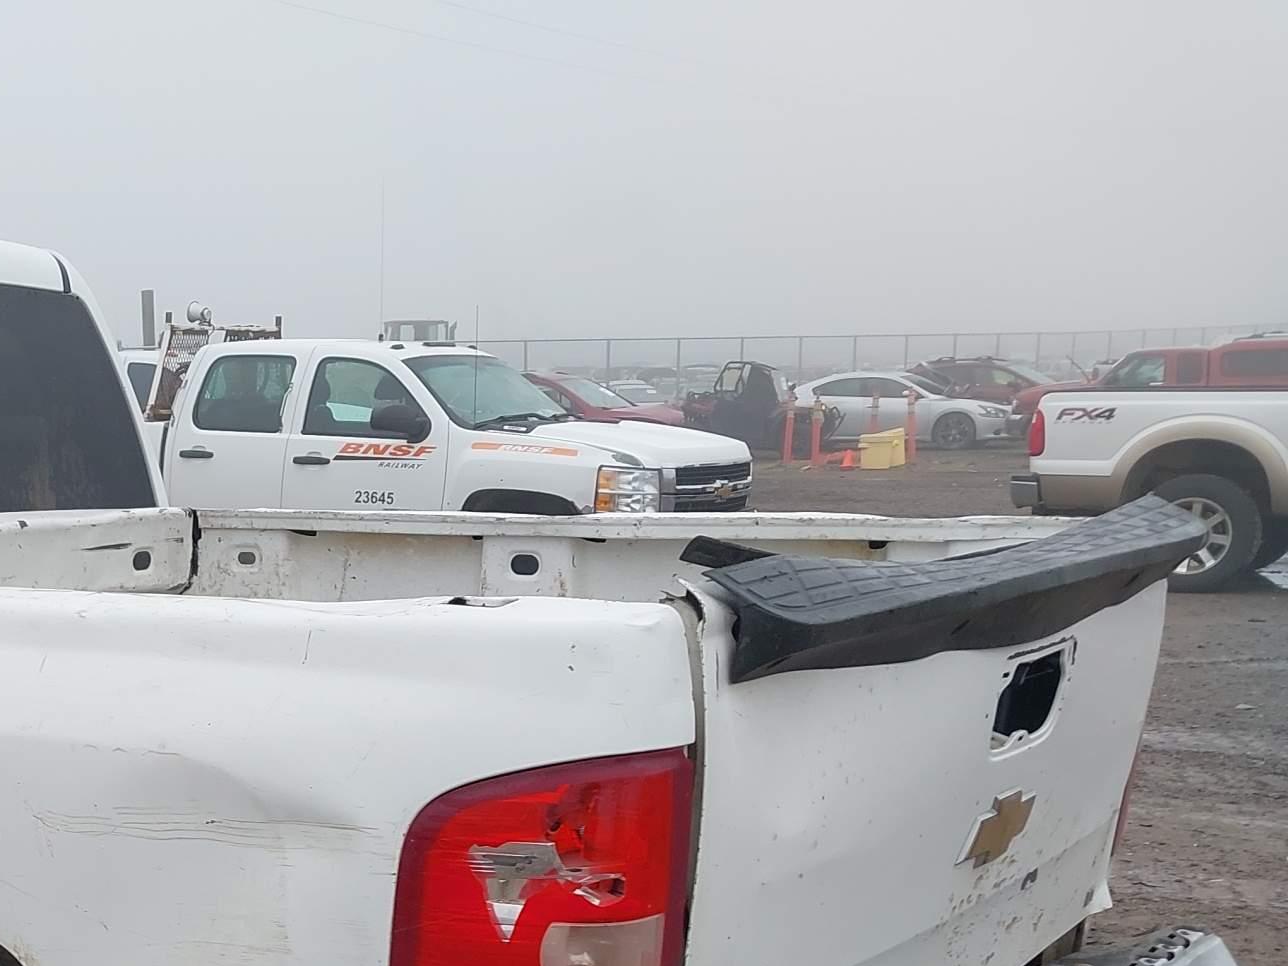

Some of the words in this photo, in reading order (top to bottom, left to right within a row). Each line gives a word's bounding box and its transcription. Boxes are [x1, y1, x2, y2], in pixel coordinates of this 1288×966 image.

[1056, 407, 1117, 420] FX4
[338, 442, 437, 457] BNSF
[377, 461, 423, 470] RAILWAY
[354, 490, 395, 505] 23645
